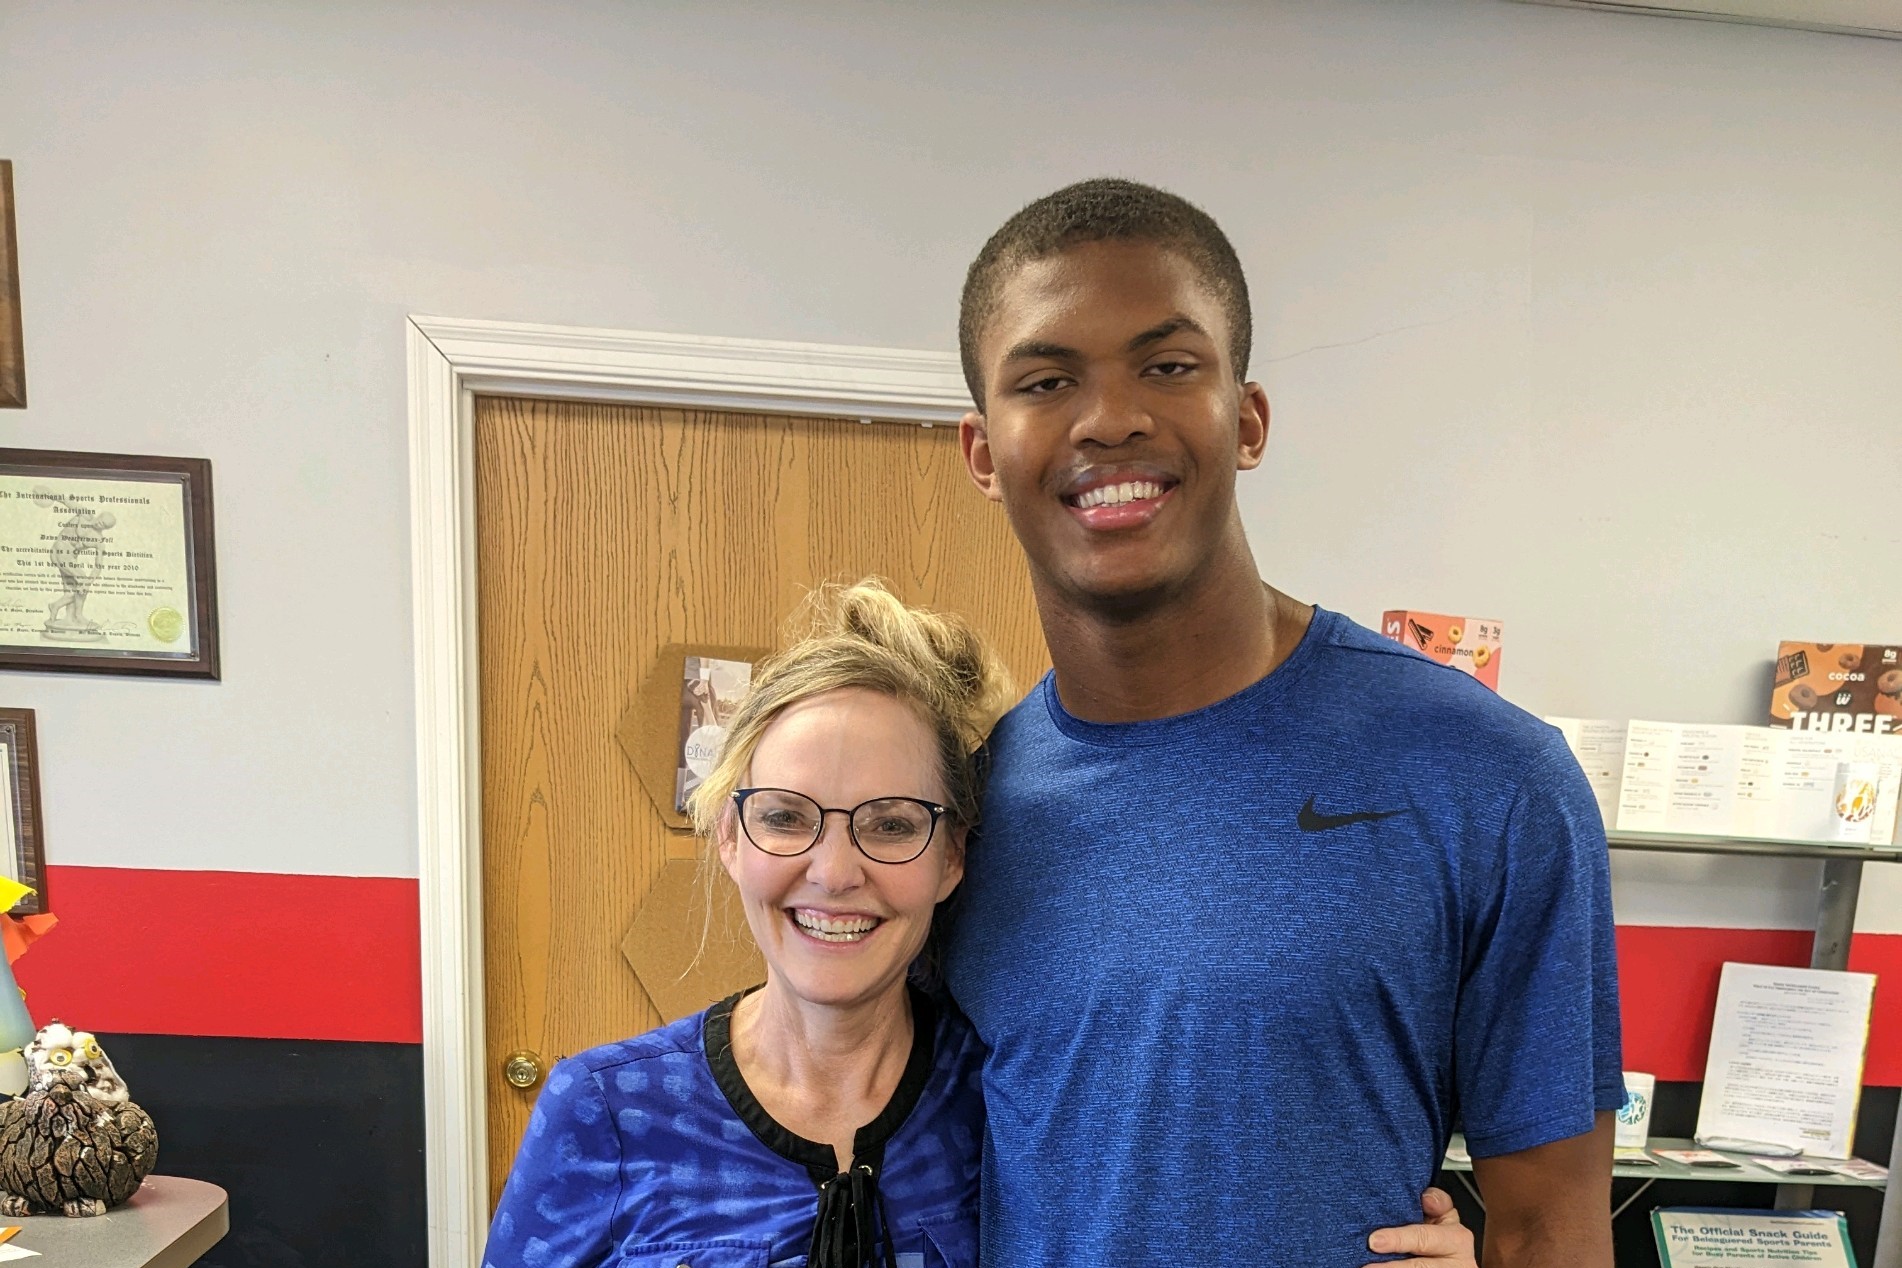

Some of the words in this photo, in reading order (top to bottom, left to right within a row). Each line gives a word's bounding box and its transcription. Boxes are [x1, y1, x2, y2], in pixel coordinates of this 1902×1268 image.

[16, 492, 65, 500] International
[69, 494, 95, 502] Sports
[99, 496, 150, 504] Professionals
[53, 506, 96, 515] Association
[1434, 645, 1474, 657] cinnamon
[1884, 649, 1897, 661] 8g
[1828, 672, 1865, 682] cocoa
[1790, 711, 1893, 735] THREE
[1671, 1225, 1695, 1235] The
[1700, 1226, 1744, 1237] Official
[1749, 1228, 1788, 1239] Snack
[1793, 1230, 1829, 1240] Guide
[1693, 1236, 1753, 1245] Beleaguered
[1757, 1238, 1790, 1247] Sports
[1793, 1240, 1832, 1248] Parents
